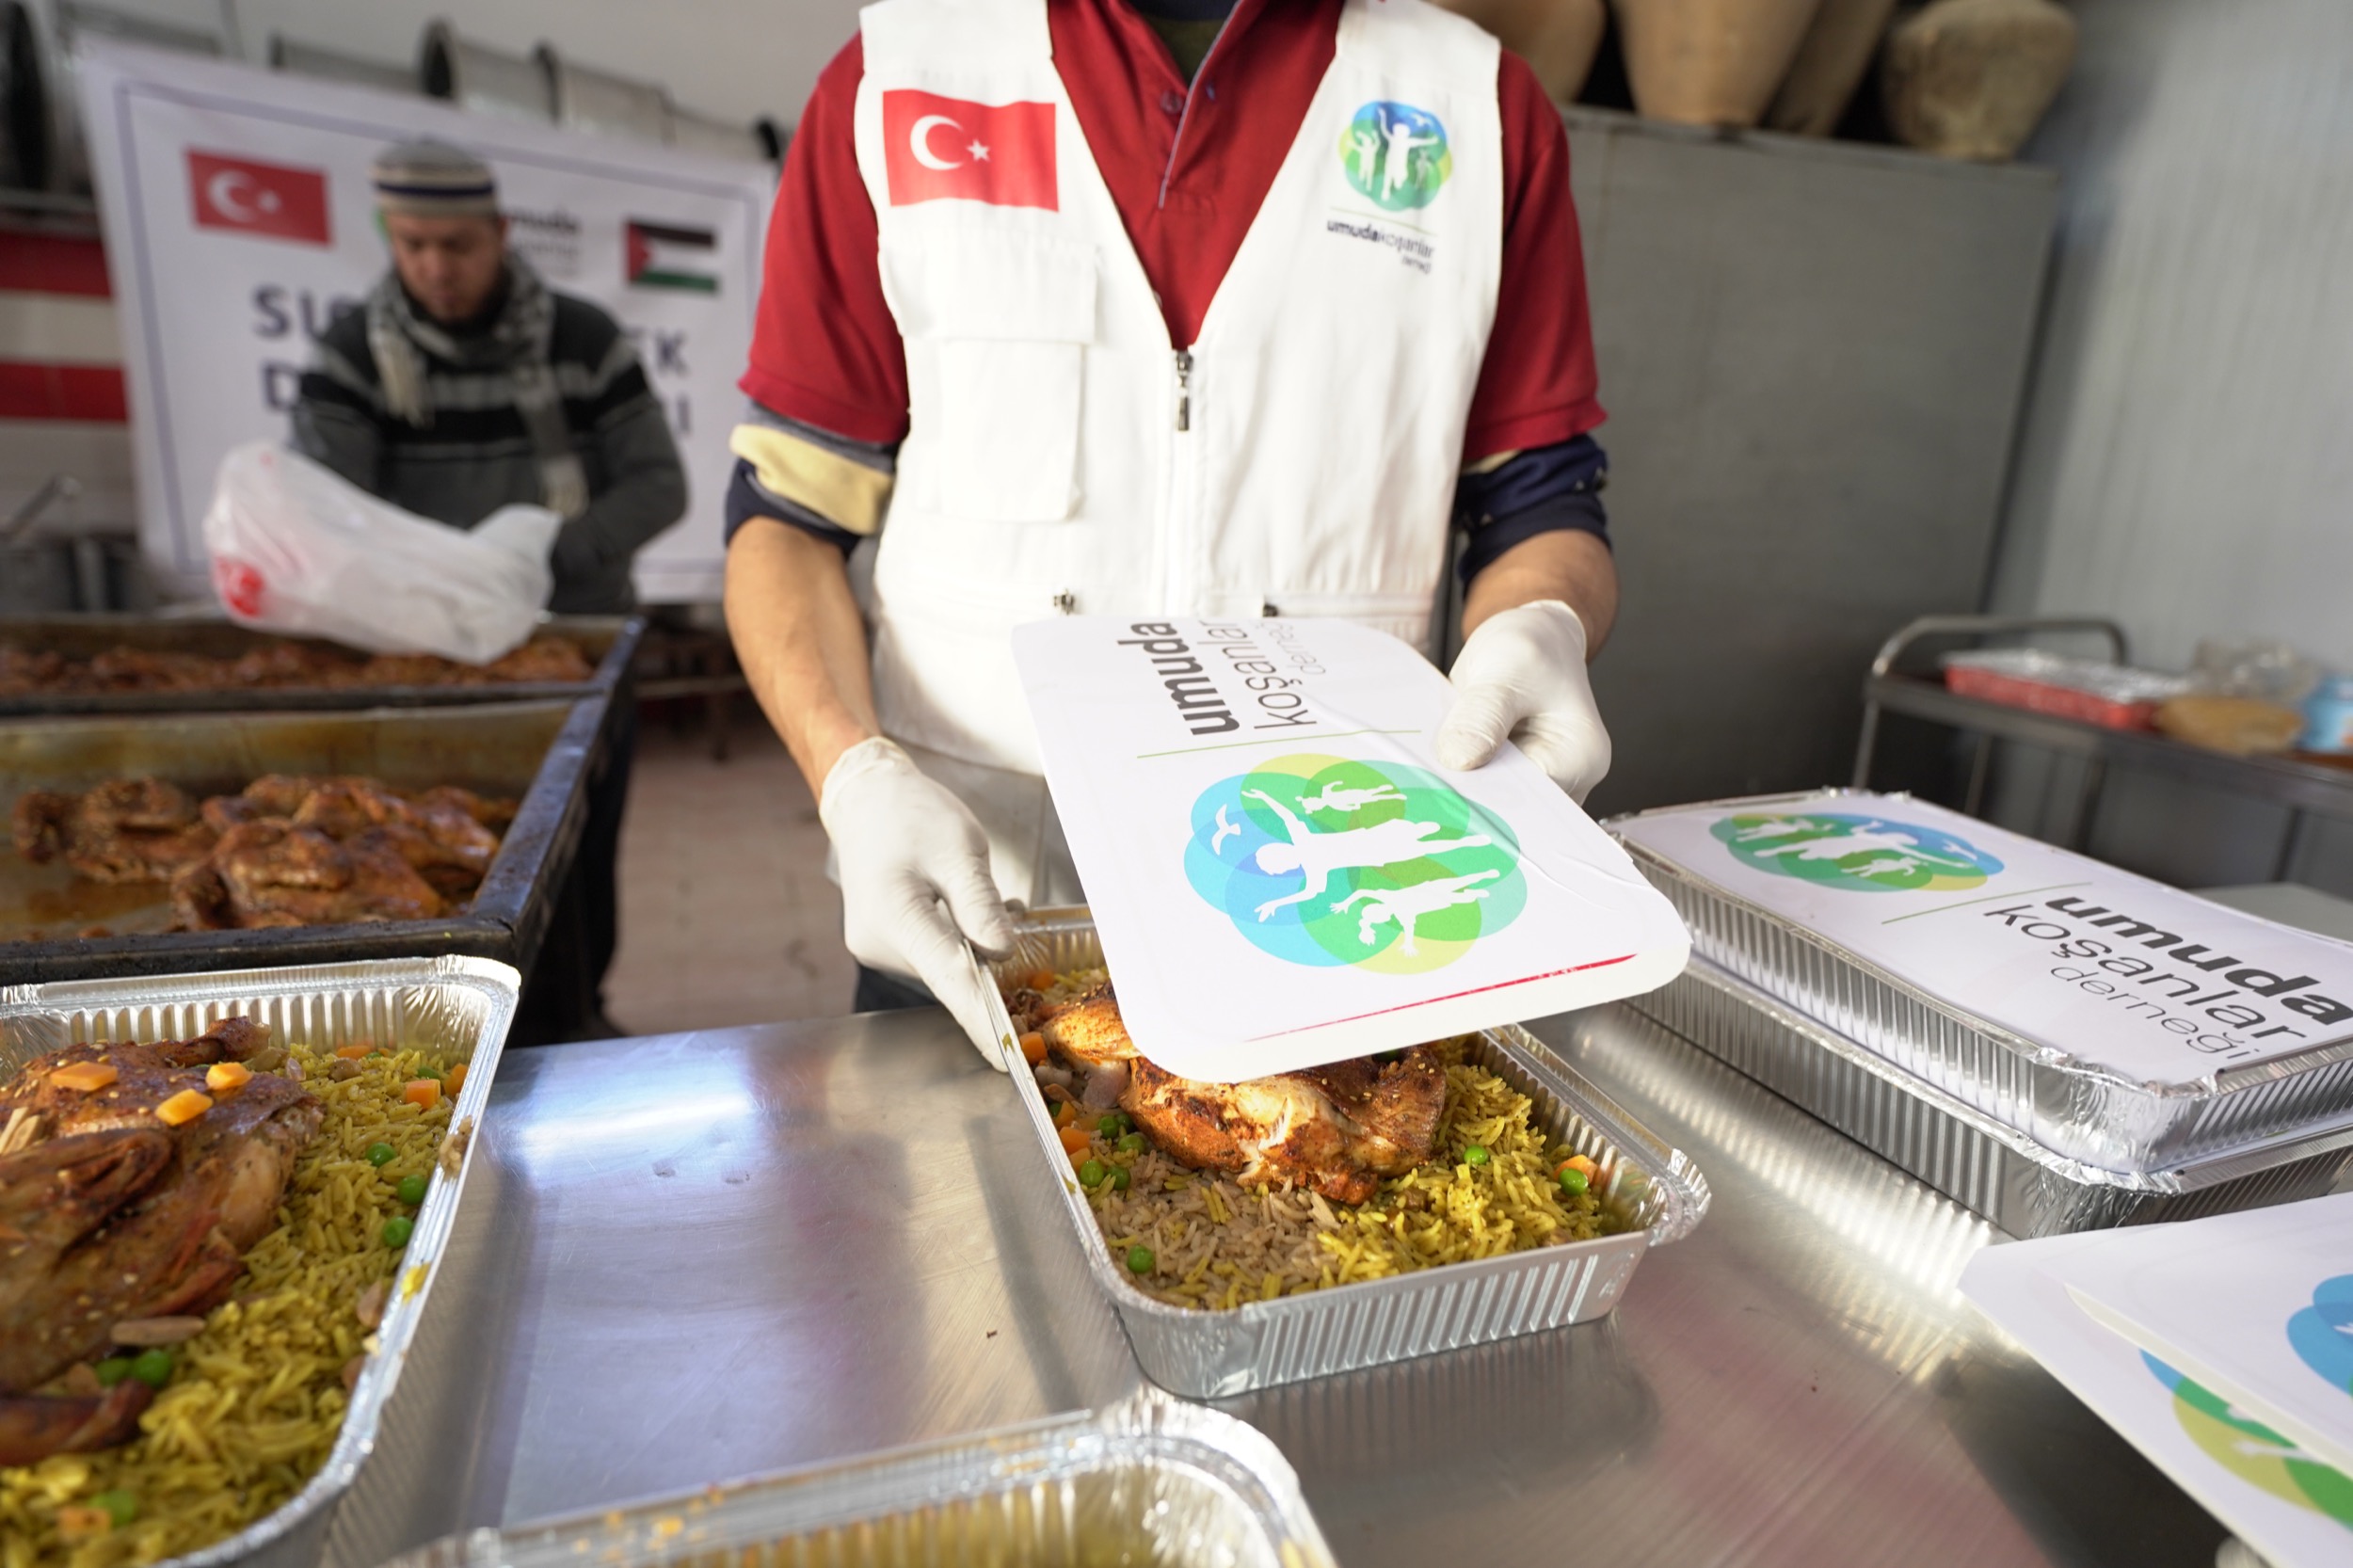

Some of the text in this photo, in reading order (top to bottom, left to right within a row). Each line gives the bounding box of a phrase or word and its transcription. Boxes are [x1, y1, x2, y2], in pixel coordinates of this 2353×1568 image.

[1116, 622, 1241, 736] umuda
[1196, 619, 1318, 730] koşanlar
[1982, 904, 2308, 1039] koşanlar
[2044, 896, 2353, 1026] umuda
[2050, 966, 2260, 1060] derneği
